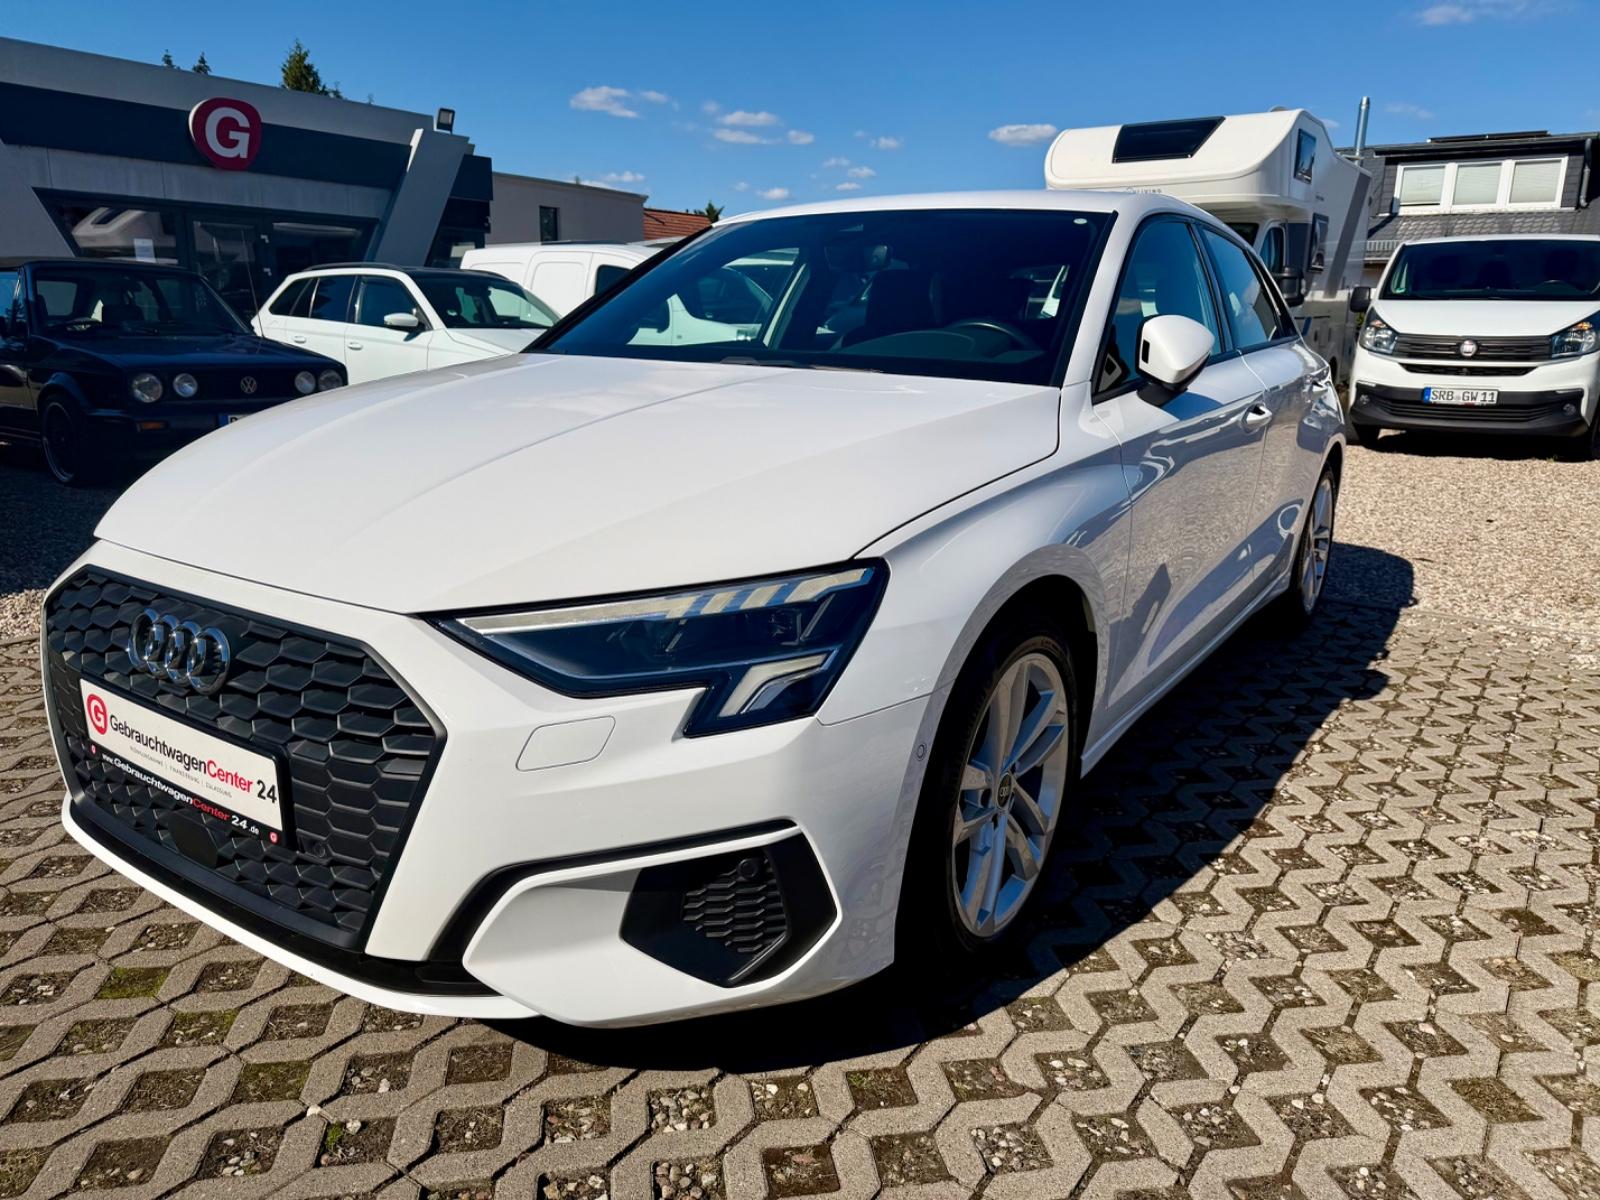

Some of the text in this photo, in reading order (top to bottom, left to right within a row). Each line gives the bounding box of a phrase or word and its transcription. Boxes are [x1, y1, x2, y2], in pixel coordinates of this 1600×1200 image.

[205, 106, 250, 158] G
[1431, 390, 1495, 403] SRB GW 11
[110, 714, 253, 793] GebrauchtwagenCenter
[257, 779, 277, 803] 24
